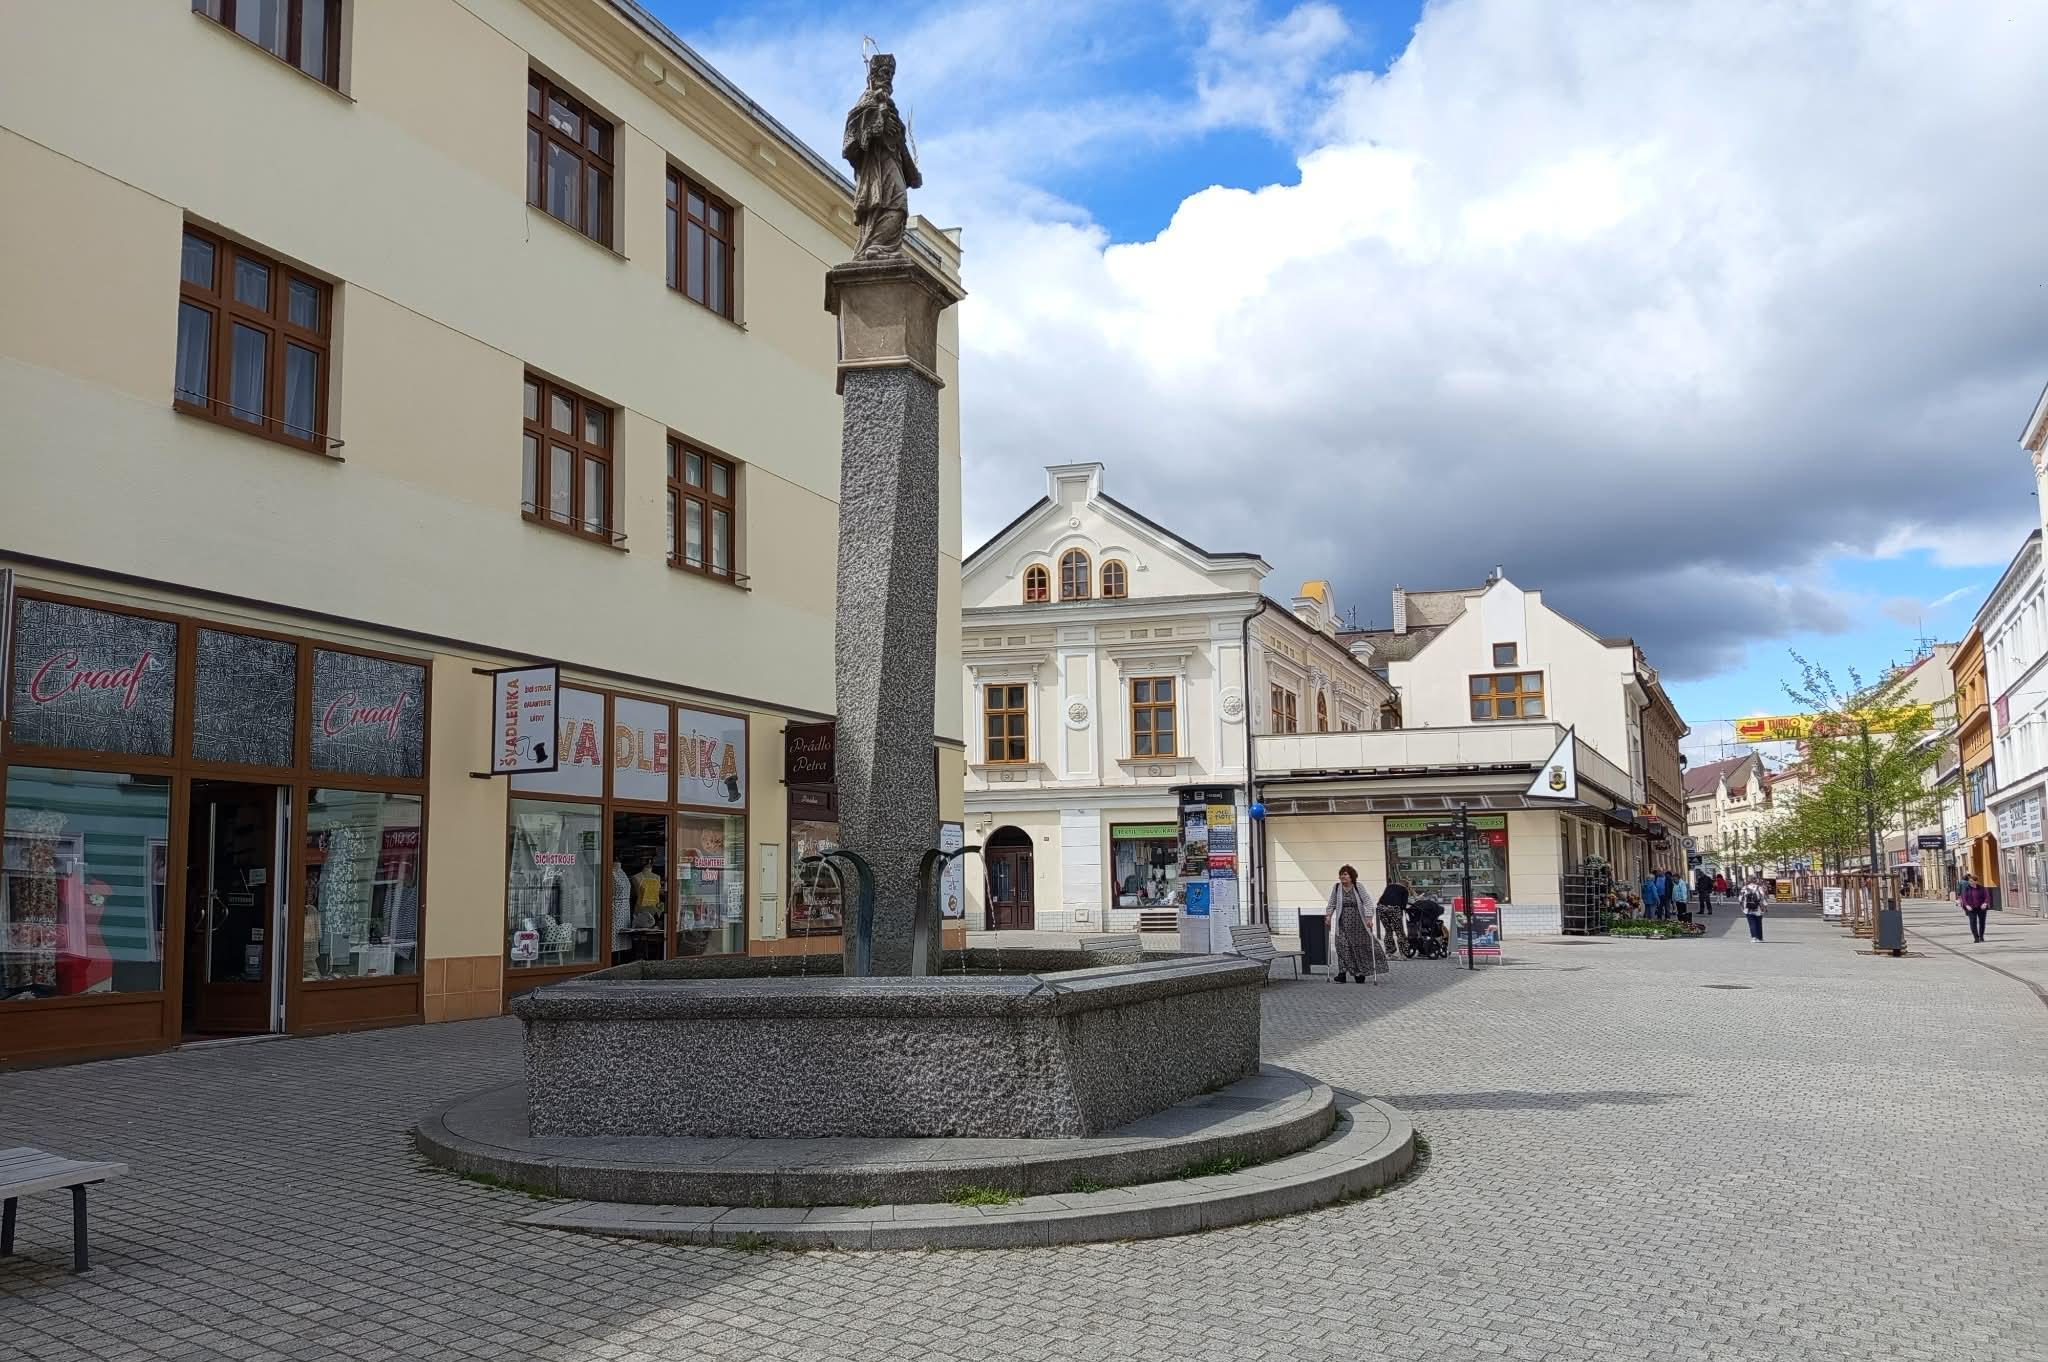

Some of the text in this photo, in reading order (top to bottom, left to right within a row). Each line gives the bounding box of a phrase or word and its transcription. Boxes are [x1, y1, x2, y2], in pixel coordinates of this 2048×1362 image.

[31, 651, 151, 710] Craaf
[534, 684, 552, 692] STROJE
[523, 699, 552, 709] GALANTERIE
[323, 691, 408, 741] Craaf
[499, 678, 519, 767] ŠVADLENKA
[1767, 717, 1801, 729] TURBO
[558, 720, 738, 780] VADLENKA
[789, 735, 831, 753] Prádlo
[793, 756, 827, 772] Petra
[550, 854, 576, 865] STROJE
